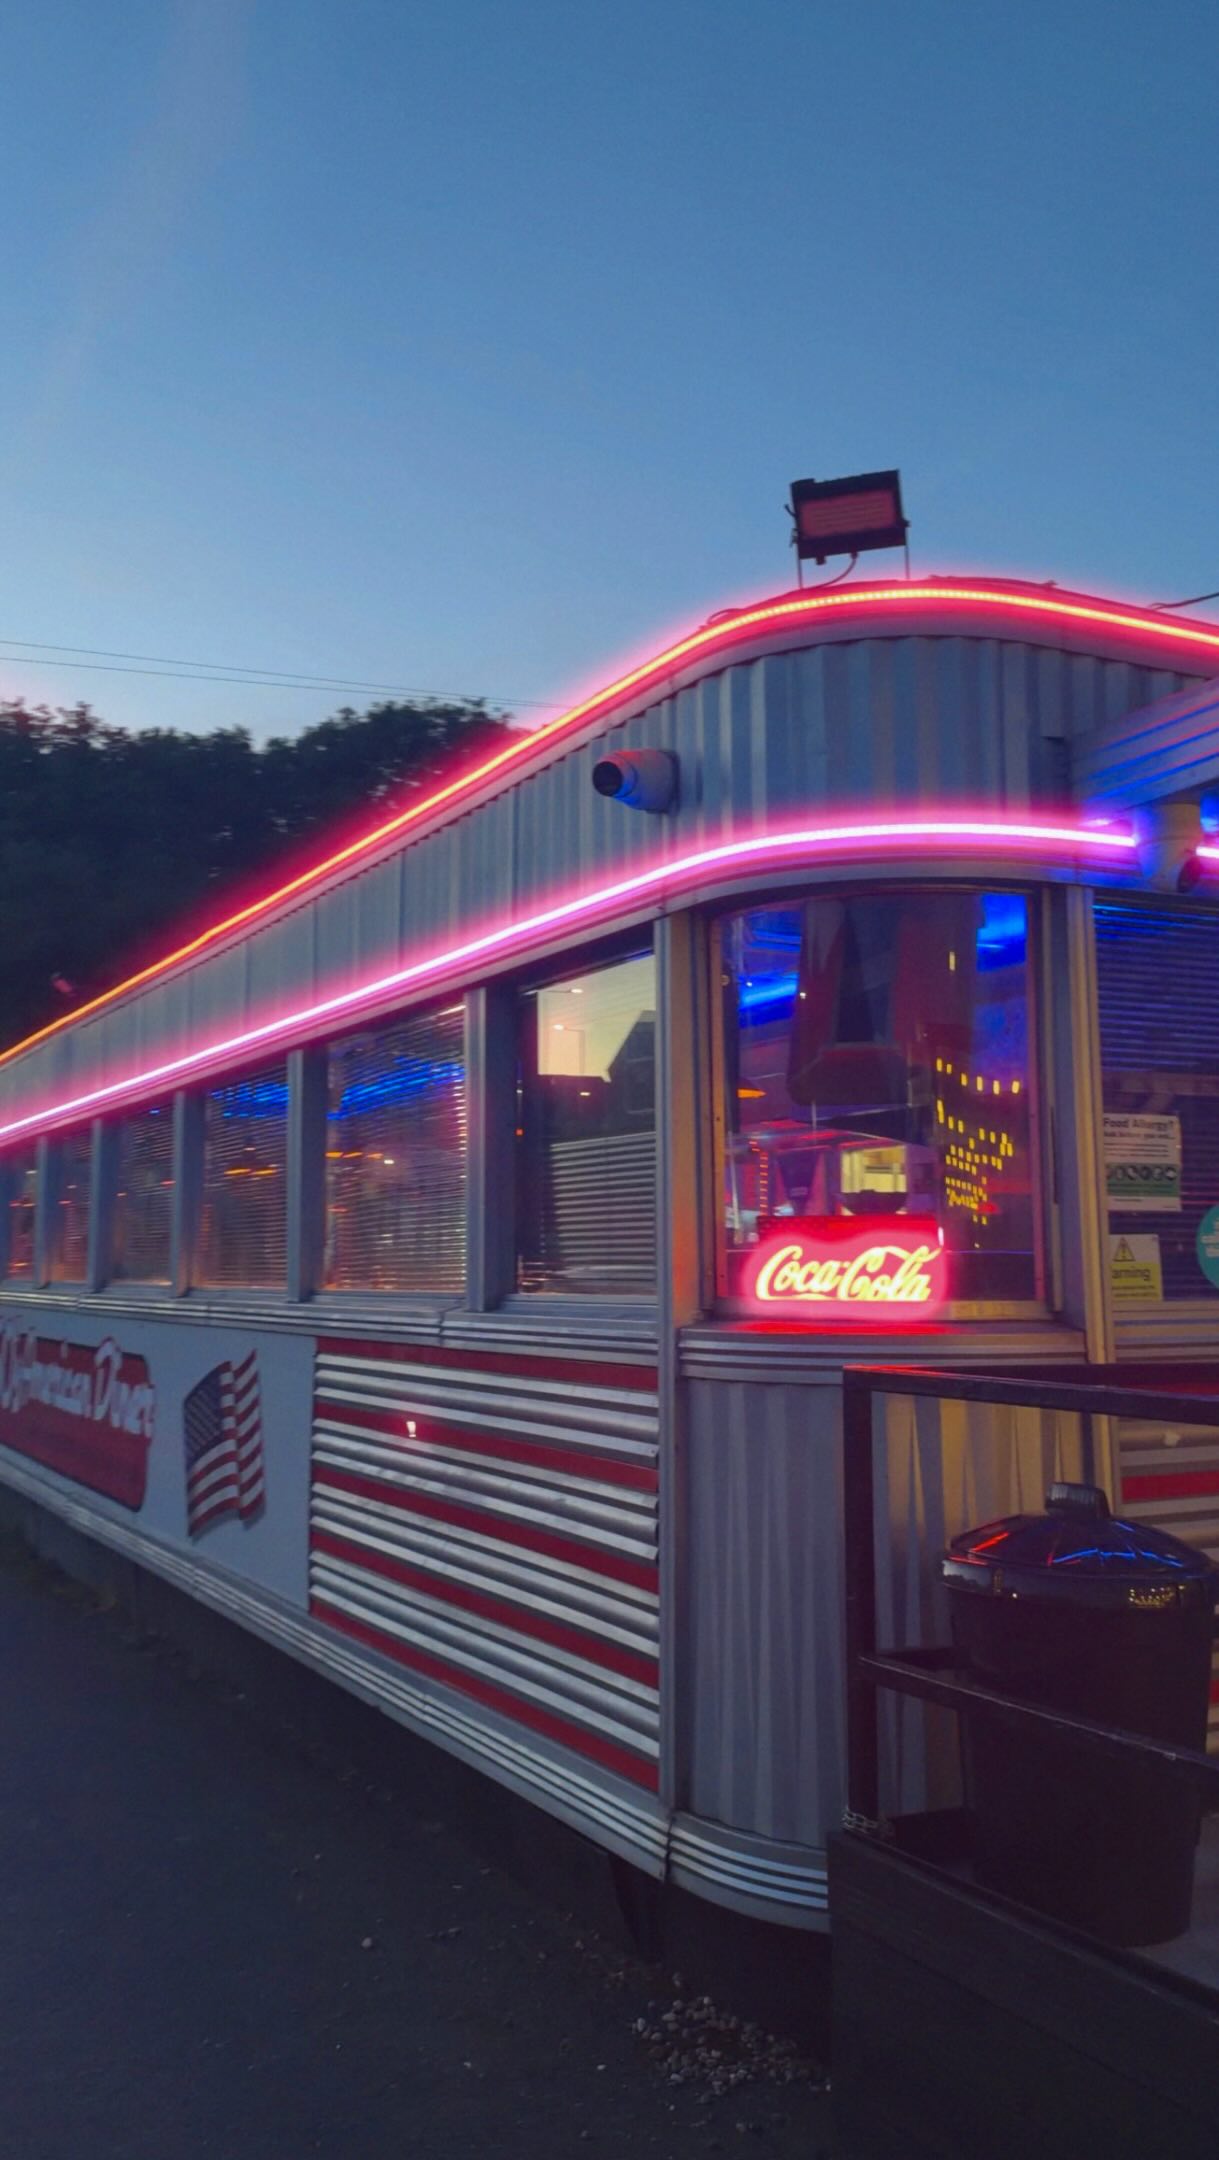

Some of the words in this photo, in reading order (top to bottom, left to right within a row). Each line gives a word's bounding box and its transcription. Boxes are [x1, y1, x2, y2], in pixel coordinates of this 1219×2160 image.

[1103, 1117, 1129, 1128] Food
[1132, 1119, 1175, 1132] Allergy?
[756, 1245, 943, 1302] Coca-Cola
[1111, 1266, 1151, 1281] arning
